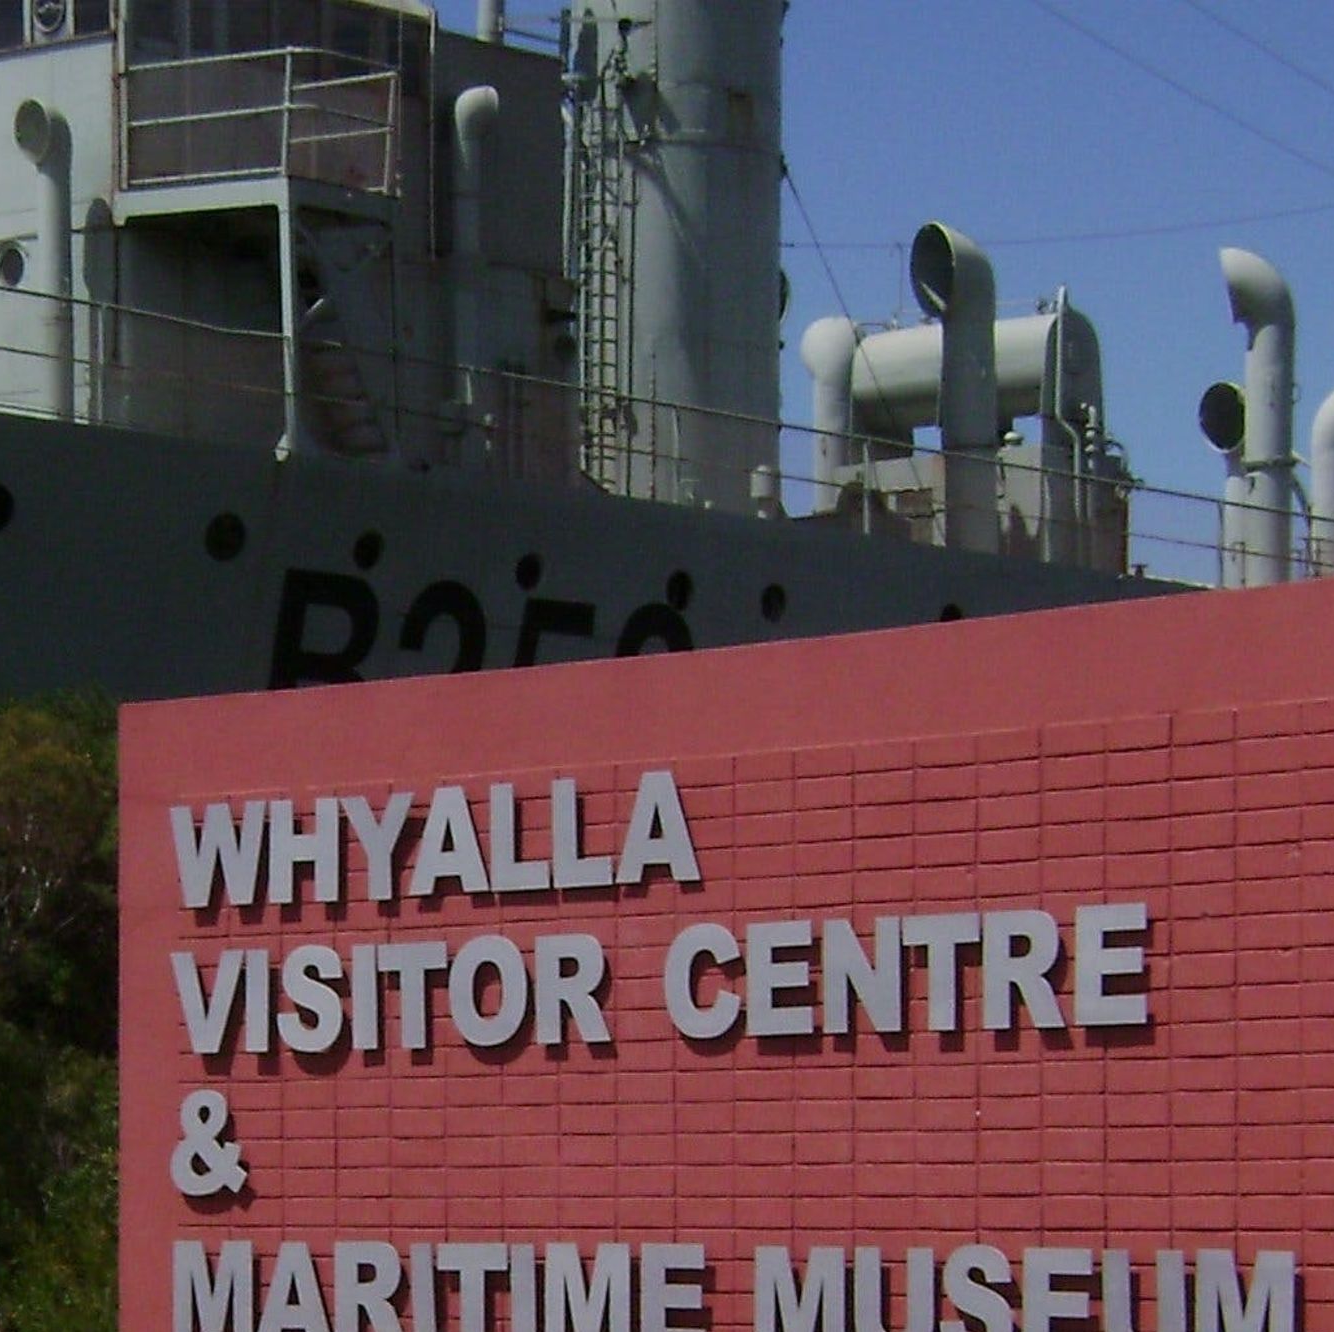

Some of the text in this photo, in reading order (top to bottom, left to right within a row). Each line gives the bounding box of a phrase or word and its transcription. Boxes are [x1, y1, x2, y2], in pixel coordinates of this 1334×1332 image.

[170, 770, 701, 909] WHYALLA
[170, 903, 1149, 1055] VISITOR CENTRE
[170, 1089, 249, 1197] &
